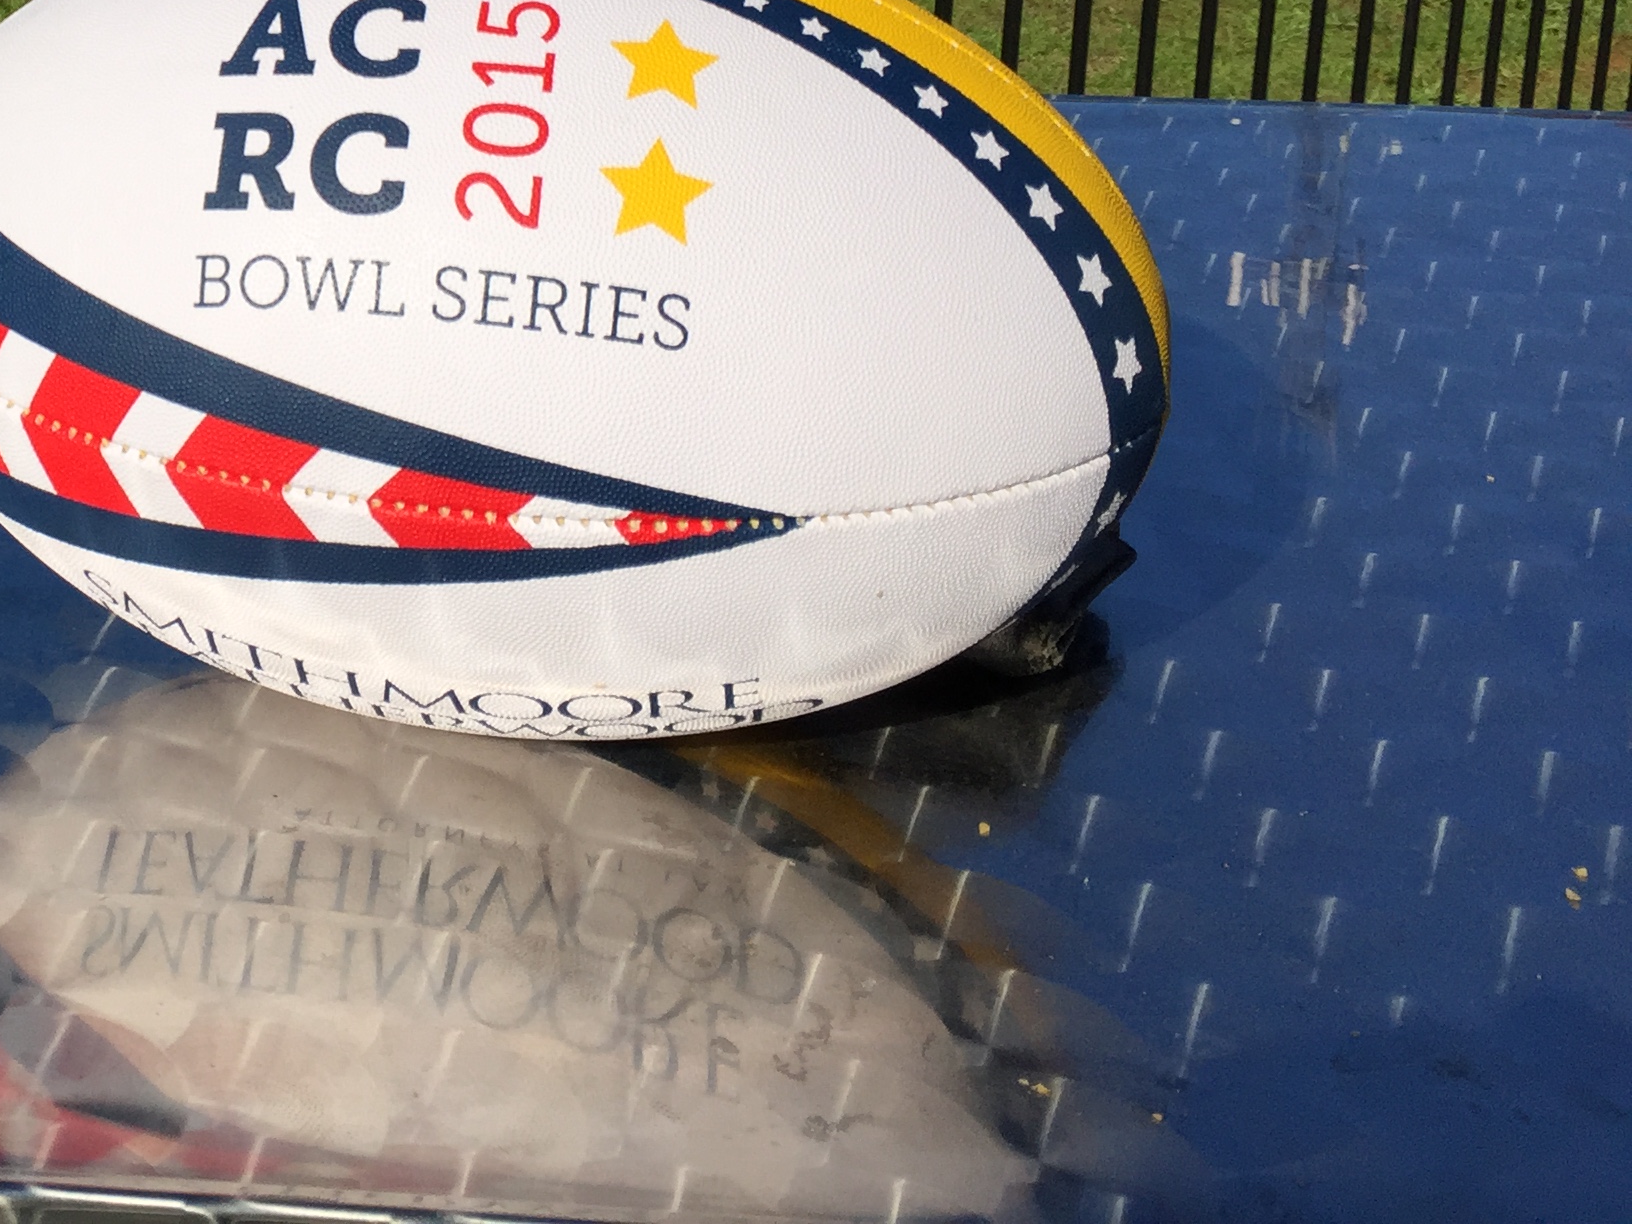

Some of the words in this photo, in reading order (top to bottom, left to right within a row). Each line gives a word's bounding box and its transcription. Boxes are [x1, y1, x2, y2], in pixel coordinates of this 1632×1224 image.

[202, 111, 411, 216] RC
[192, 253, 406, 319] BOWL
[430, 263, 693, 353] SERIES
